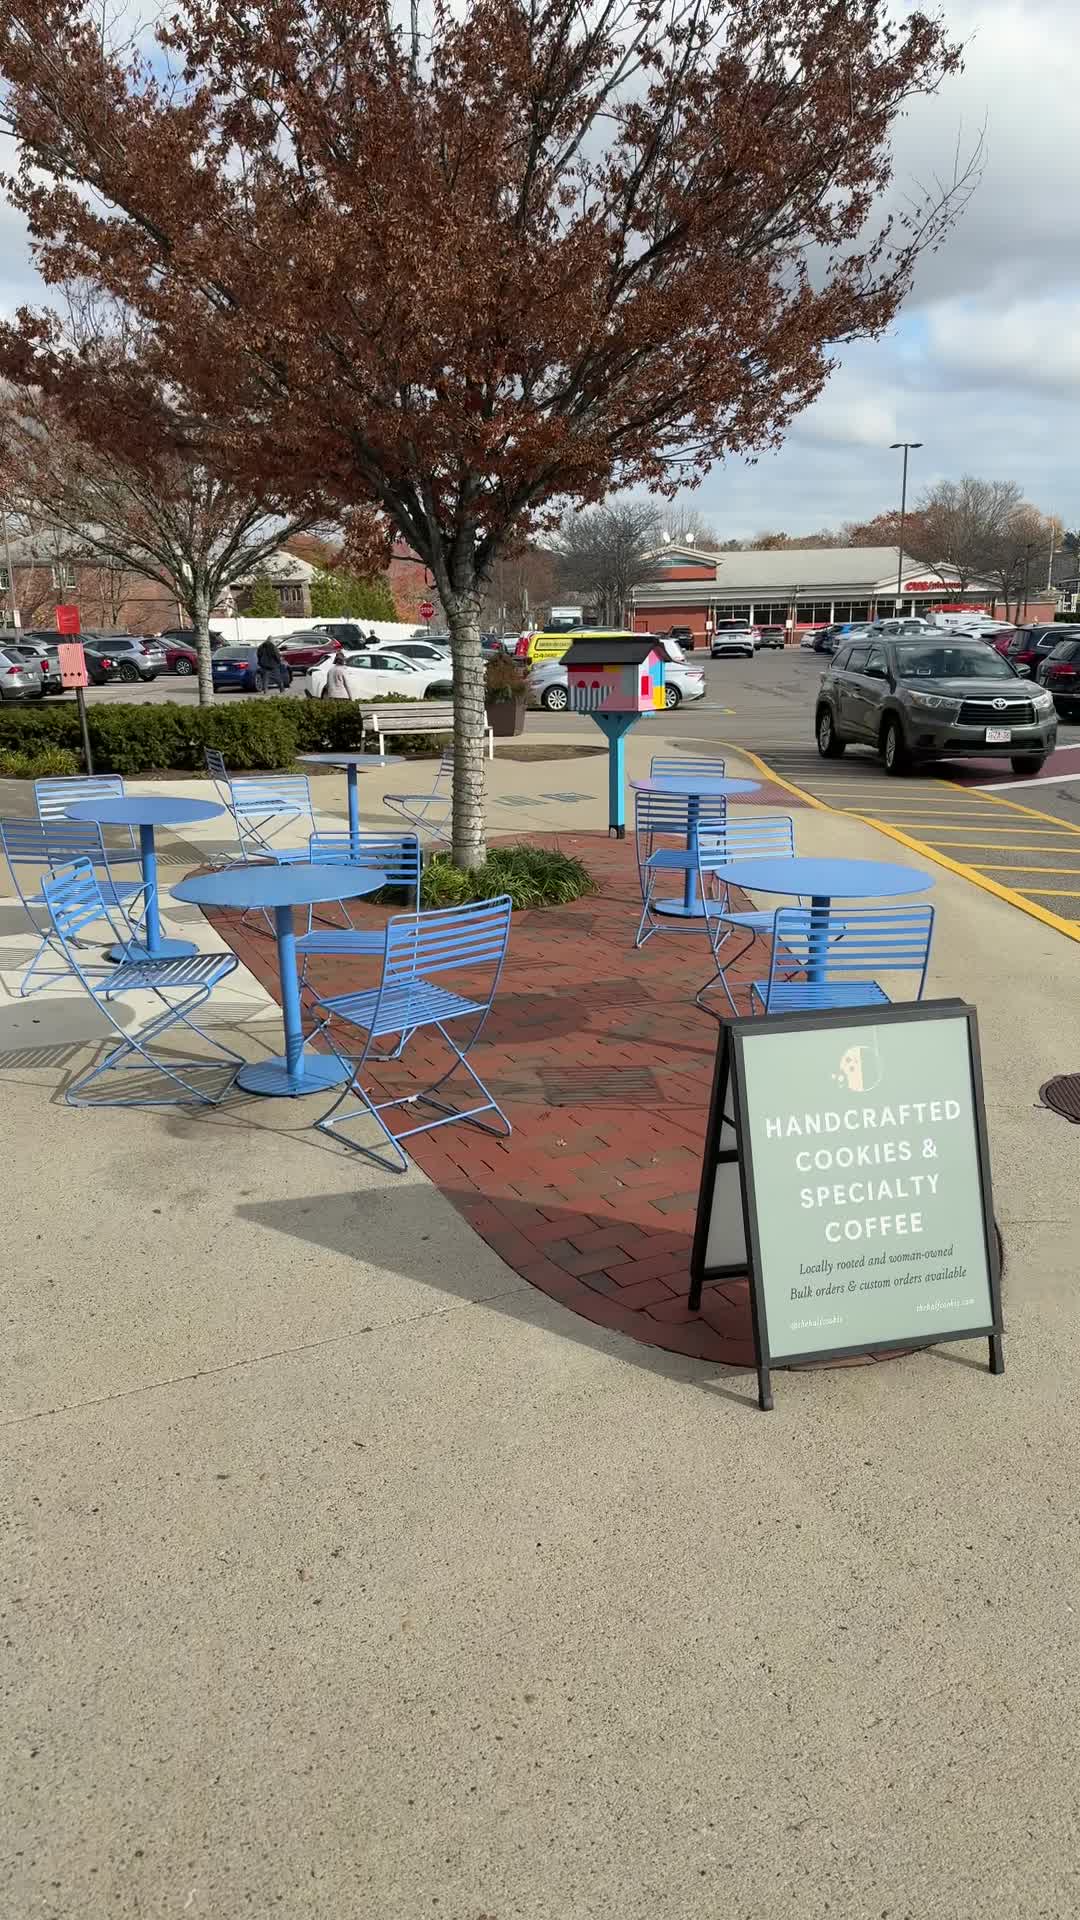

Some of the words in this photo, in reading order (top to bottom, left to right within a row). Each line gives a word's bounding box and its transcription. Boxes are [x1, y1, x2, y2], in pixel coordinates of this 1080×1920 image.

[765, 1100, 961, 1138] HANDCRAFTED
[796, 1141, 911, 1171] COOKIES
[922, 1138, 938, 1158] &
[800, 1174, 939, 1208] SPECIALTY
[825, 1212, 923, 1242] COFFEE
[799, 1259, 833, 1276] Locally
[837, 1255, 865, 1270] rooted
[868, 1251, 886, 1266] and
[889, 1243, 953, 1263] woman-owned
[790, 1285, 813, 1300] Bulk
[815, 1282, 845, 1297] orders
[847, 1280, 857, 1292] &
[860, 1278, 891, 1291] custom
[893, 1272, 922, 1287] orders
[924, 1266, 967, 1282] available
